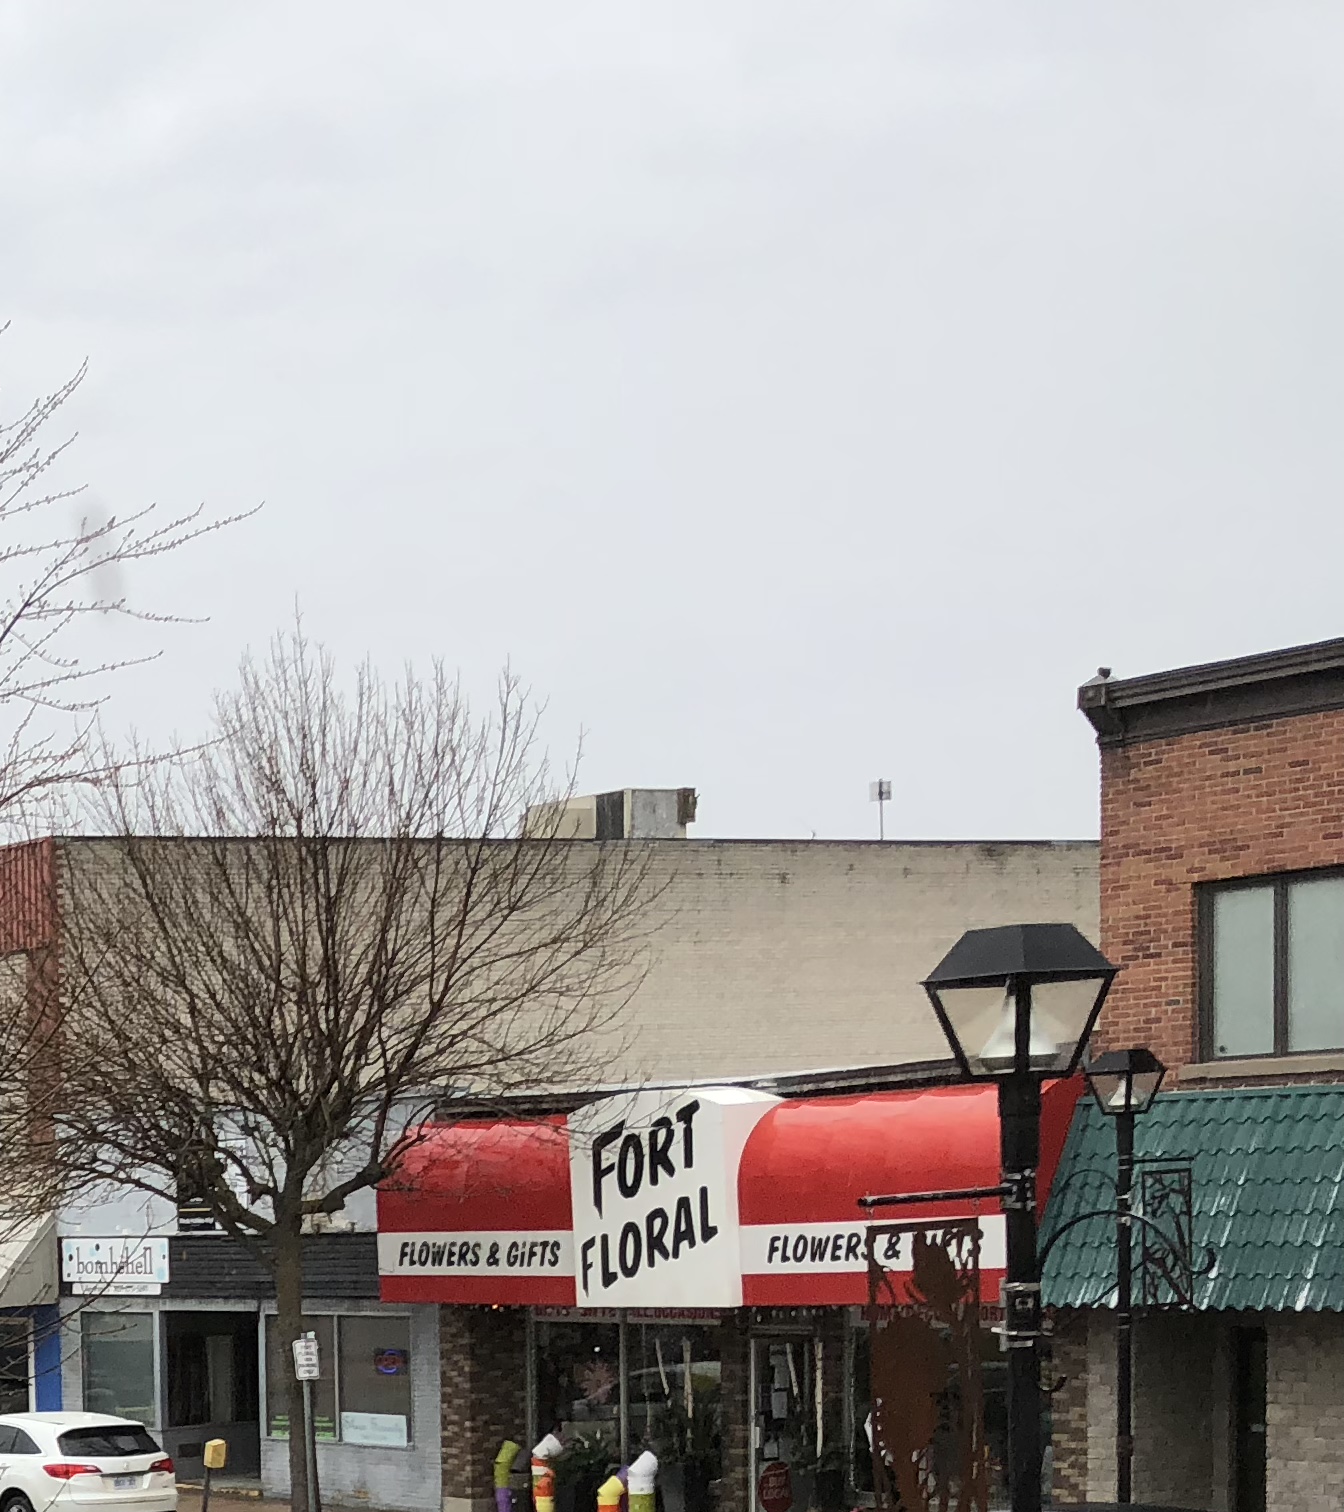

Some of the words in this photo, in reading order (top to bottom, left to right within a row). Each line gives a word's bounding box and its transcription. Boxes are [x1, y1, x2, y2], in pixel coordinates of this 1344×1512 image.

[592, 1099, 700, 1219] FORT
[398, 1240, 481, 1267] FLOWERS
[486, 1240, 500, 1267] &
[580, 1186, 718, 1298] FLORAL
[882, 1231, 901, 1260] &
[75, 1246, 153, 1275] bombshell
